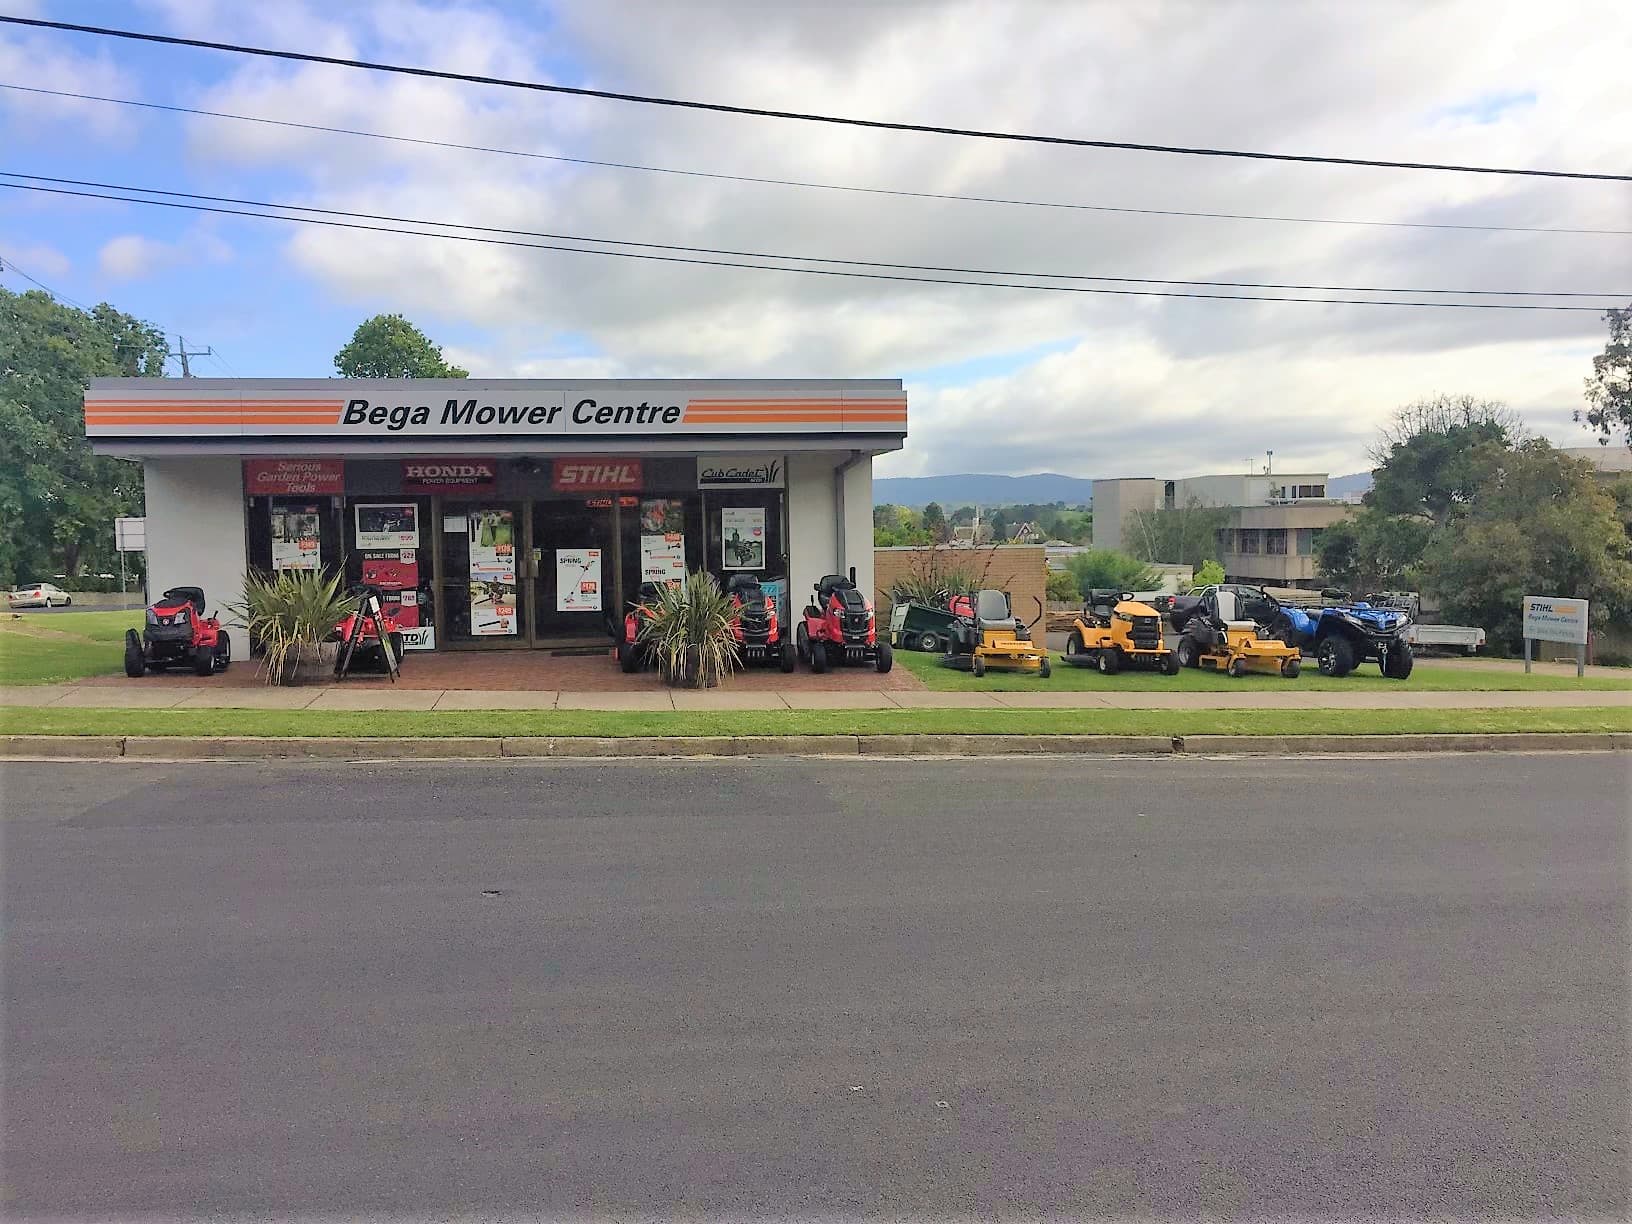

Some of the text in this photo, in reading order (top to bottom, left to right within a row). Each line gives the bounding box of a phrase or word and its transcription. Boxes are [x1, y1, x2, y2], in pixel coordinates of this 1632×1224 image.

[343, 399, 681, 431] Bega Mower Centre
[277, 461, 321, 472] Serious
[405, 465, 493, 477] HONDA
[257, 471, 341, 482] Garden Power
[559, 465, 637, 484] STIHL
[701, 467, 765, 479] Cub Cadet
[287, 482, 316, 493] Tools
[1530, 603, 1553, 613] STIHL
[402, 633, 418, 641] TD
